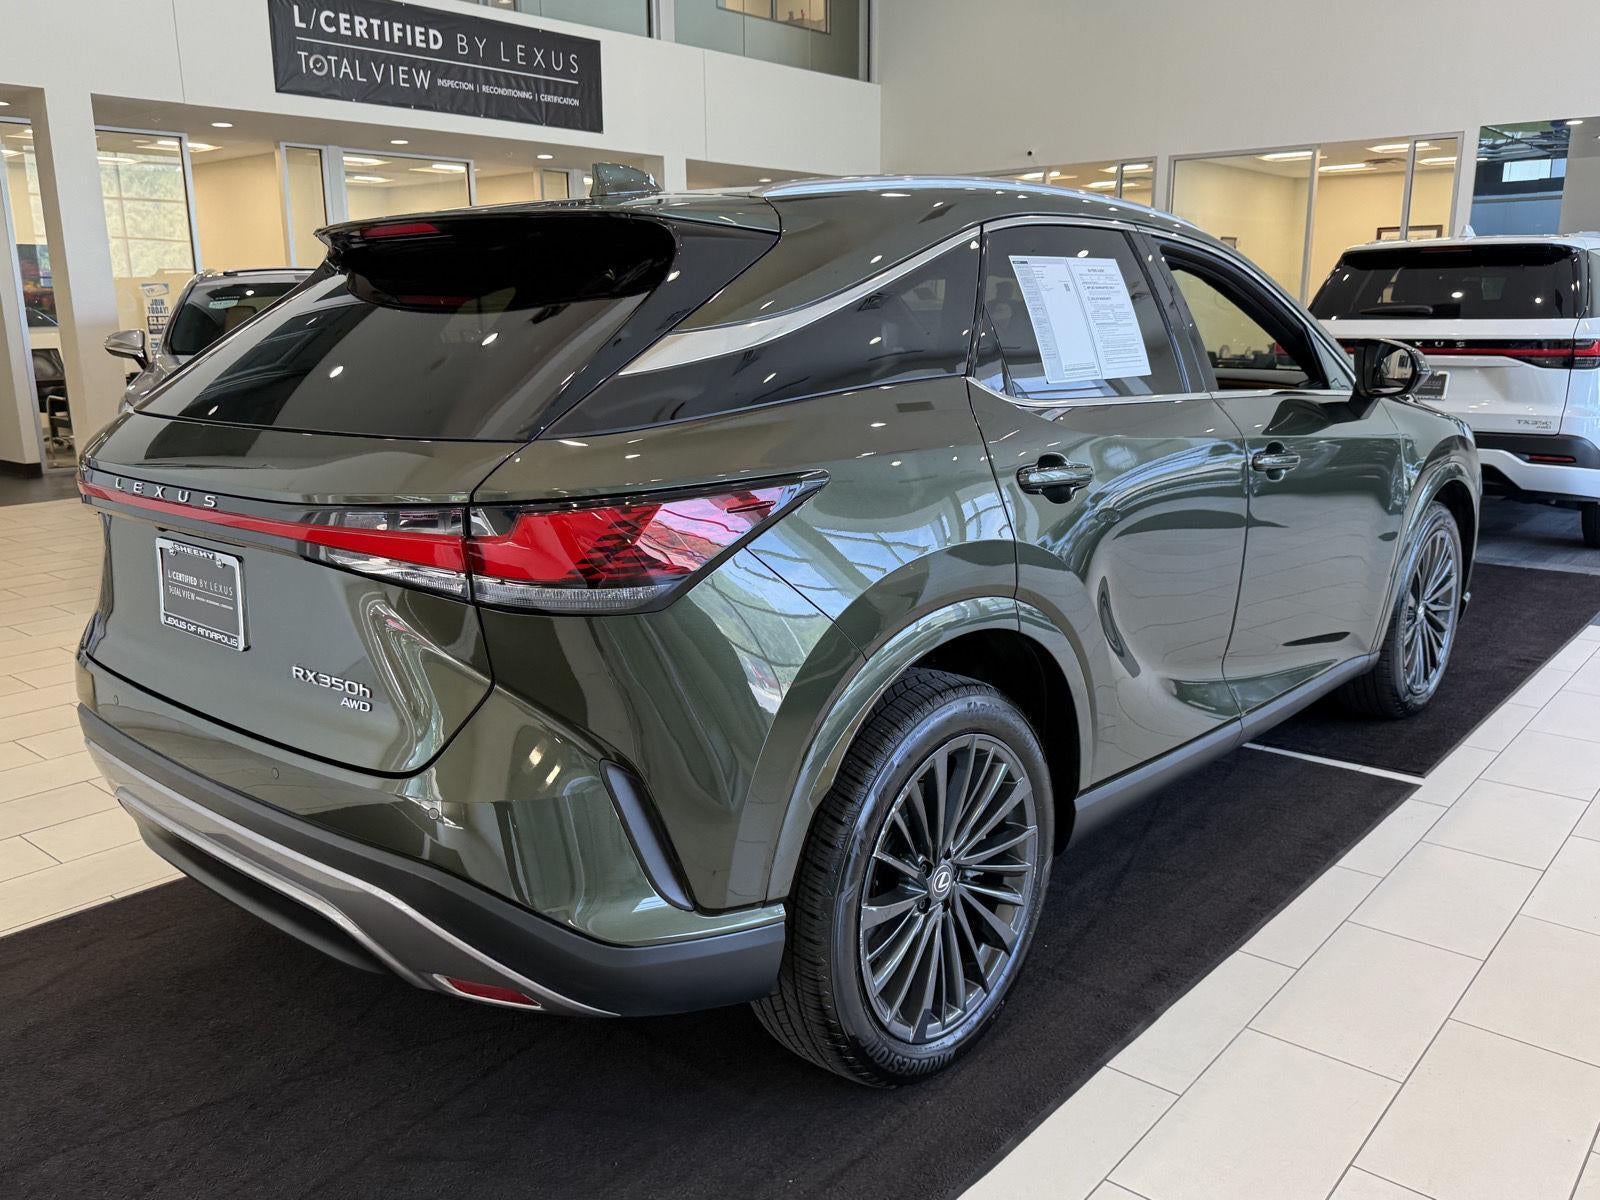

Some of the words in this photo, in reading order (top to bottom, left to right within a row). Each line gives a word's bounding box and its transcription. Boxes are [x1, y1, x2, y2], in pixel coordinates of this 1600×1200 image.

[293, 4, 443, 50] L/CERTIFIED
[456, 33, 487, 58] BY
[500, 41, 579, 74] LEXUS
[437, 78, 475, 91] INSPECTION
[481, 84, 533, 100] RECONDITIONING
[539, 93, 580, 107] CERTIFICATION
[115, 477, 216, 508] LEXUS
[174, 544, 214, 560] SHEEHY
[199, 578, 208, 588] BY
[209, 581, 233, 596] LEXUS
[164, 616, 187, 630] LEXUS
[187, 622, 197, 633] OF
[197, 627, 238, 647] ANNAPOLIS
[292, 665, 373, 699] RX350h
[340, 697, 372, 713] AWD
